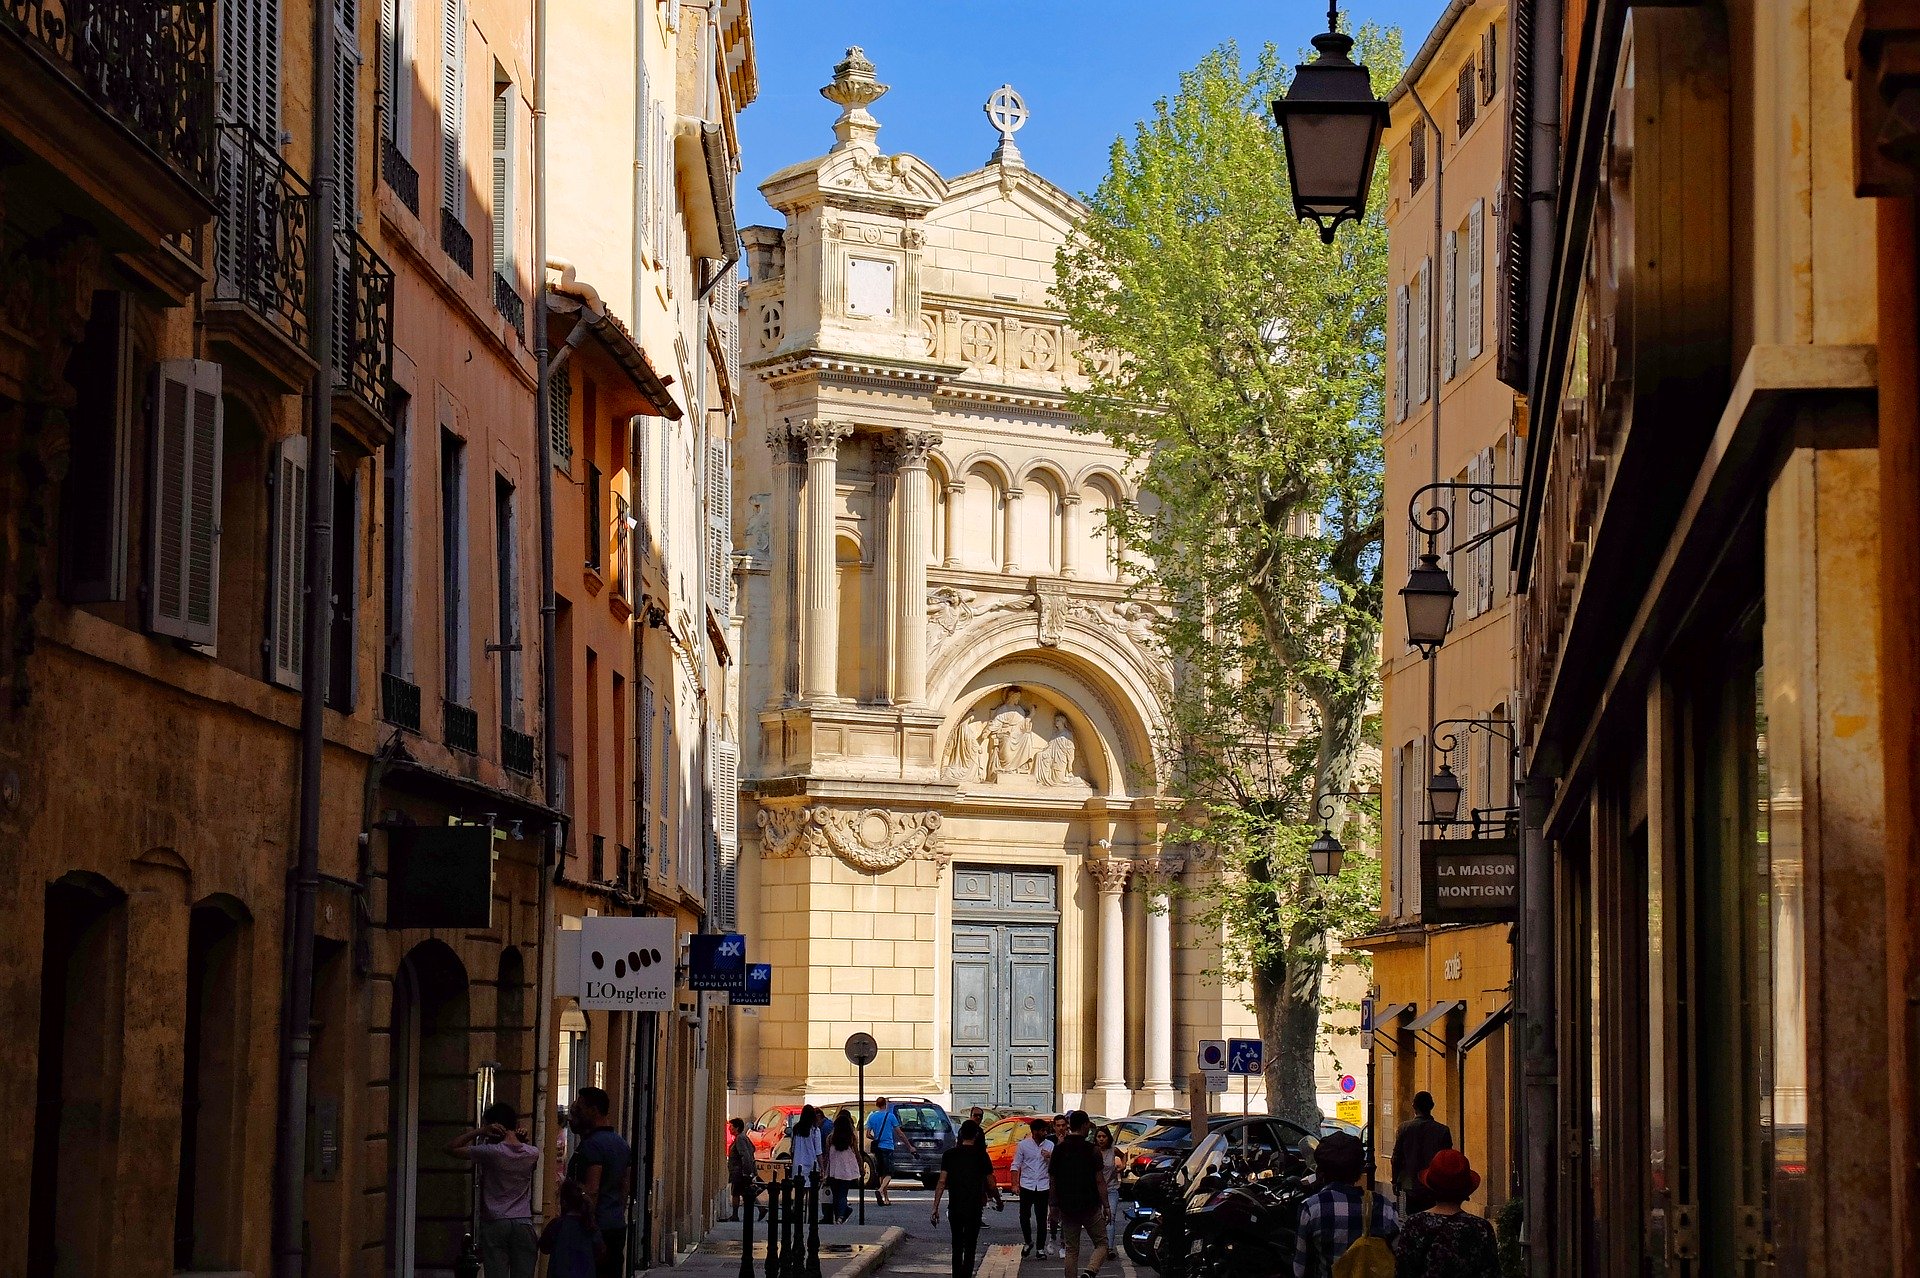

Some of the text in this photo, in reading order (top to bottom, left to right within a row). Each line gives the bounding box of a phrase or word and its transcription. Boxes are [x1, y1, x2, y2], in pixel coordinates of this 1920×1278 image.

[1438, 865, 1515, 876] LA MAISON
[1438, 886, 1515, 897] MONTIGNY
[586, 982, 667, 1003] L'Onglerie
[1363, 1005, 1369, 1026] P
